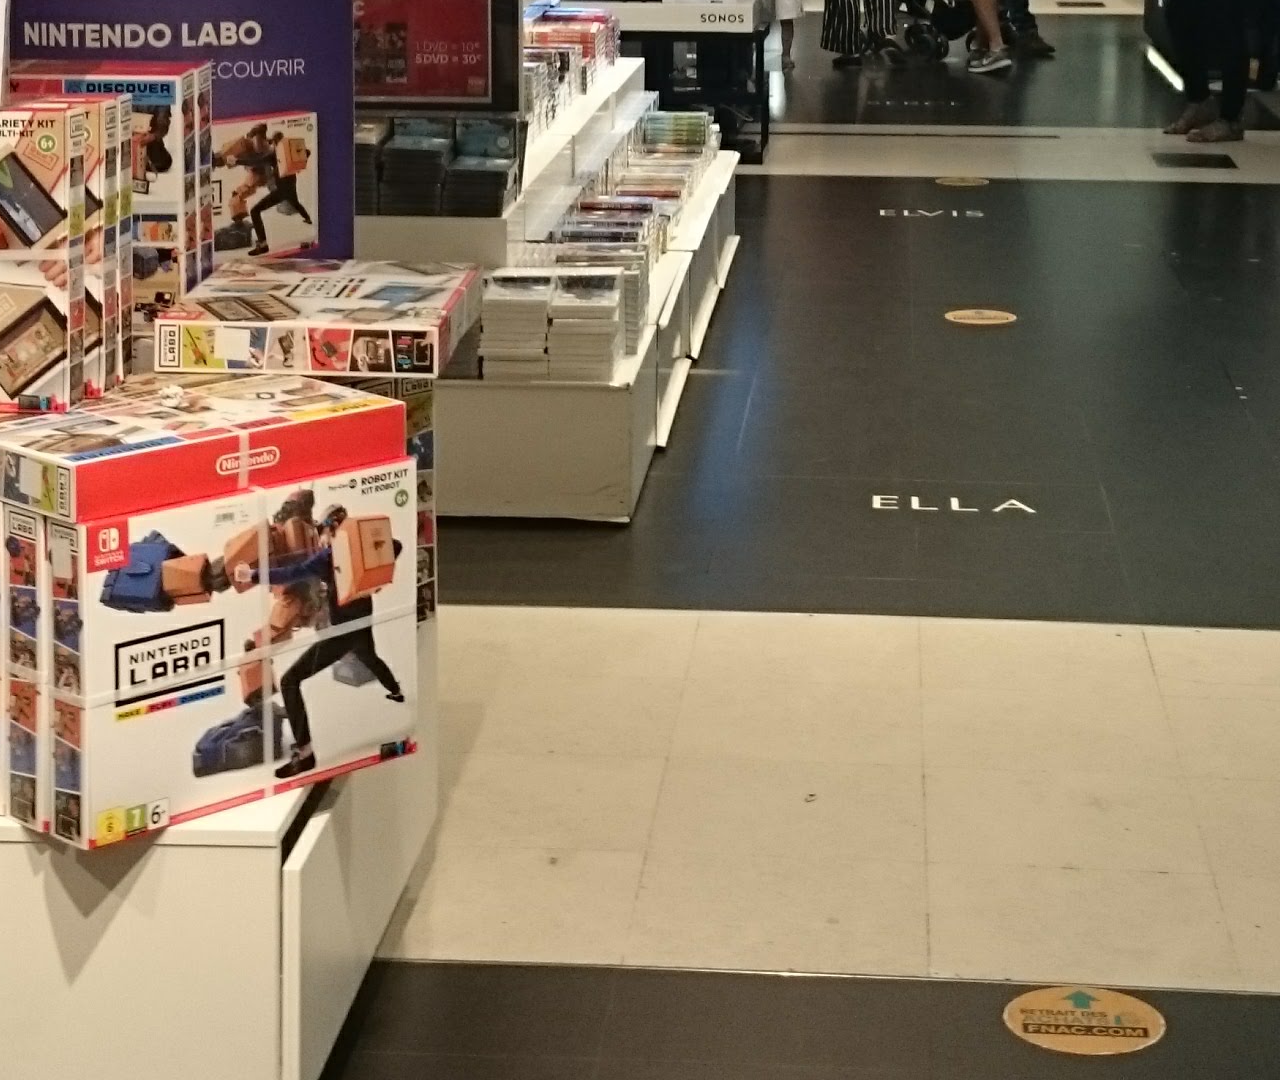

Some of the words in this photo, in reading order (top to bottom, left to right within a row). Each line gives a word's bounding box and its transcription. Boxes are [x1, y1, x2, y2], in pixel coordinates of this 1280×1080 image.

[700, 13, 745, 24] SONOS
[24, 21, 172, 49] NINTENDO
[181, 20, 262, 47] LABO
[423, 54, 449, 64] DVD
[210, 58, 305, 80] ÉCOUVRIR
[86, 80, 171, 95] DISCOVER
[37, 119, 56, 129] KIT
[40, 138, 54, 149] 6+
[879, 209, 984, 217] ELVIS
[168, 330, 176, 362] LABO
[221, 450, 278, 470] Nintendo
[361, 472, 392, 487] ROBOT
[393, 469, 409, 481] KIT
[361, 485, 375, 496] KIT
[375, 480, 401, 493] ROBOT
[872, 495, 1037, 514] ELLA
[12, 523, 33, 535] LABO
[94, 555, 124, 567] SWITCH
[129, 636, 211, 665] NINTENDO
[129, 650, 211, 686] LABO
[1021, 1008, 1076, 1017] RETRAIT
[1023, 1016, 1109, 1026] ACHATS
[1027, 1024, 1145, 1038] FNAC.COM
